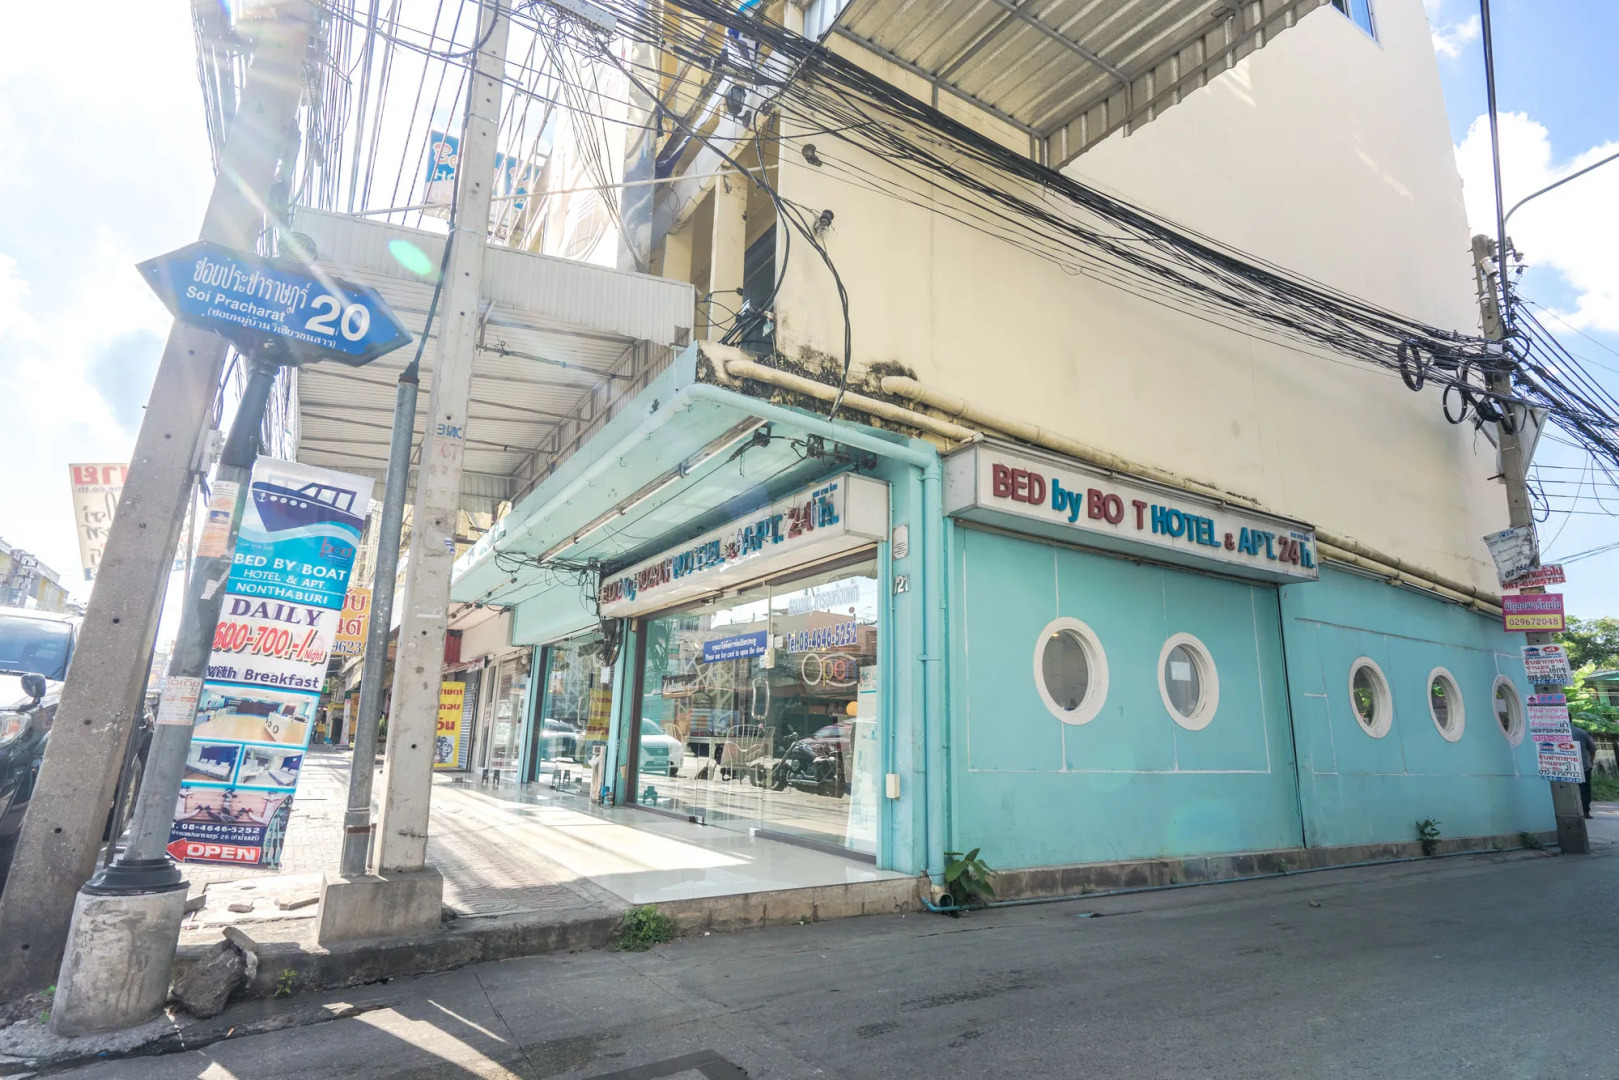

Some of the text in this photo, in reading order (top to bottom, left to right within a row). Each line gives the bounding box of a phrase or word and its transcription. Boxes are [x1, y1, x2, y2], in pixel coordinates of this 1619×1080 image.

[186, 286, 286, 322] Soi Pracharat
[305, 294, 370, 341] 20
[992, 463, 1046, 506] BED
[1052, 478, 1083, 523] by
[1151, 504, 1222, 548] HOTEL
[1224, 532, 1236, 551] &
[1237, 526, 1278, 560] APT.
[234, 552, 348, 581] BED BY BOAT
[244, 568, 326, 590] HOTEL & APT.
[235, 582, 328, 604] NONTHABURI
[230, 598, 325, 626] DAILY
[1509, 618, 1559, 626] 029672048
[786, 620, 858, 654] Tel. 08-4646-5252
[304, 648, 324, 662] Night
[244, 669, 320, 689] Breakfast
[801, 652, 858, 687] Open
[181, 823, 260, 834] 08-4646-5252
[186, 844, 256, 861] OPEN
